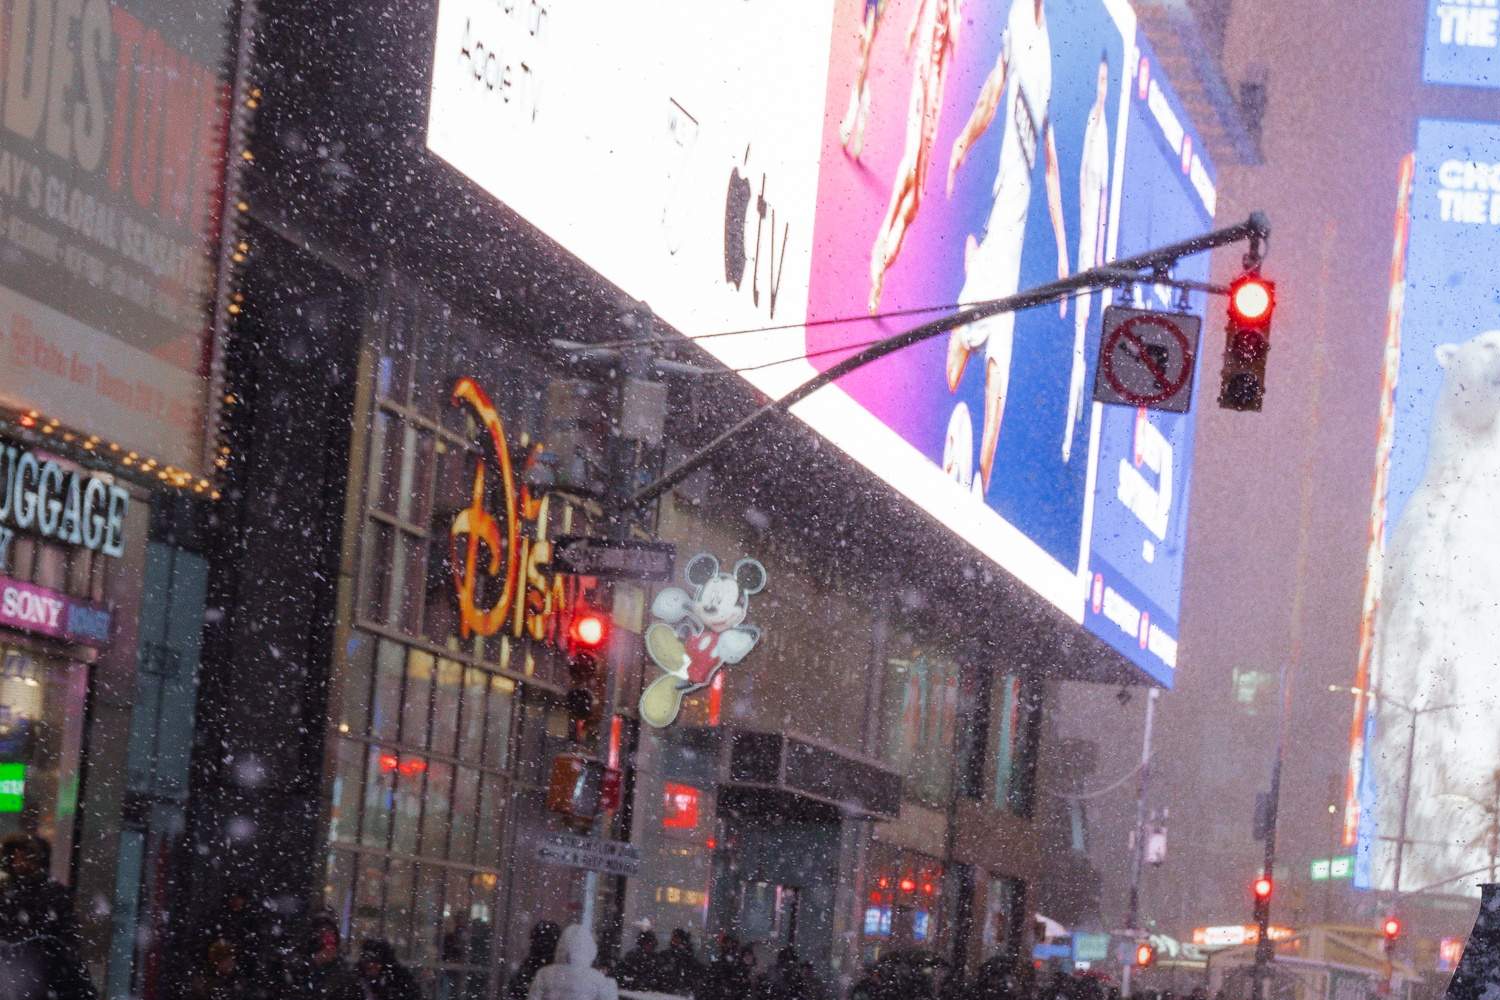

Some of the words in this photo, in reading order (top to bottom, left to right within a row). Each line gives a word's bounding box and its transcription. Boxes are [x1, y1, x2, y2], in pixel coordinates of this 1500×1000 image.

[1437, 6, 1499, 48] THE
[1437, 188, 1490, 224] THE
[1, 586, 65, 628] SONY
